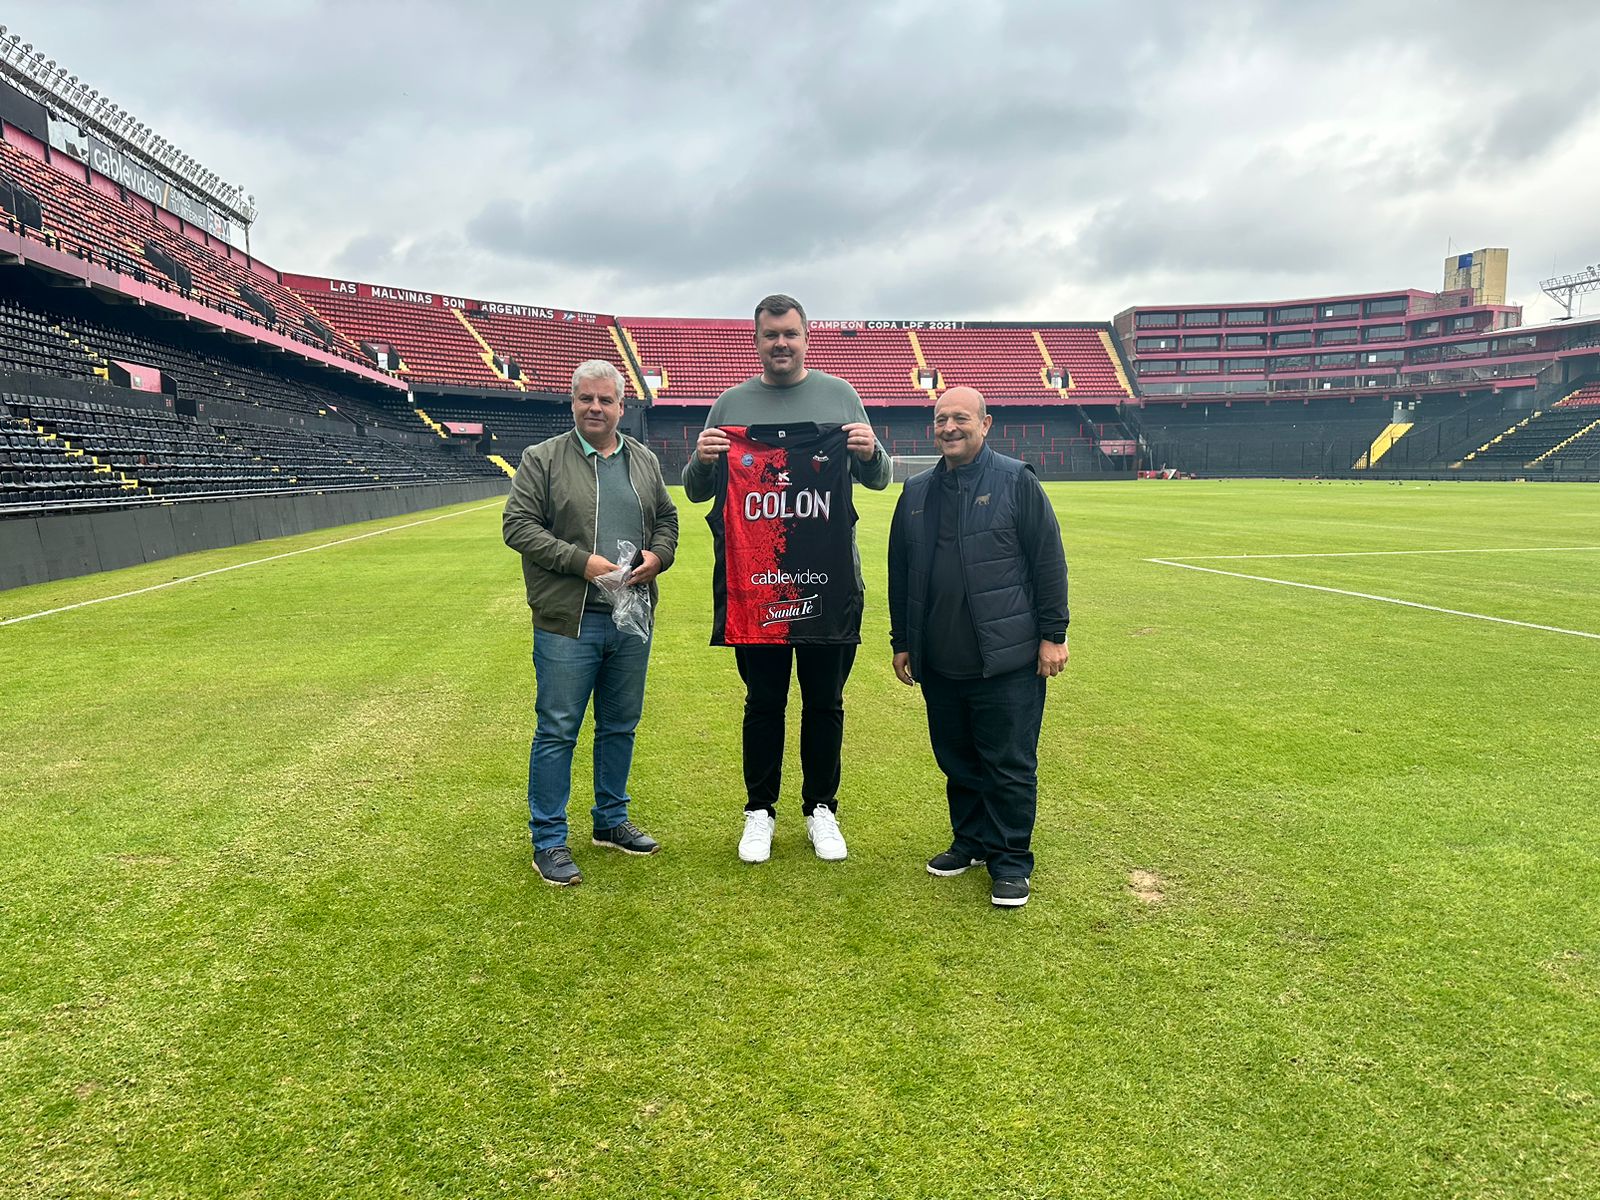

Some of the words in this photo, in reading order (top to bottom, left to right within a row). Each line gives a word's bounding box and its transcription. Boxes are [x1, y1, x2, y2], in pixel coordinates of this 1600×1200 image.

[94, 147, 161, 202] cablevideo
[330, 280, 357, 294] LAS
[371, 286, 432, 304] MALVINAS
[442, 297, 466, 309] SON
[481, 304, 554, 319] ARGENTINAS
[868, 321, 898, 330] COPA
[902, 321, 925, 330] LPF
[929, 321, 956, 330] 2021
[744, 488, 831, 522] COLÓN
[751, 569, 829, 585] cablevideo
[766, 605, 800, 620] Santa
